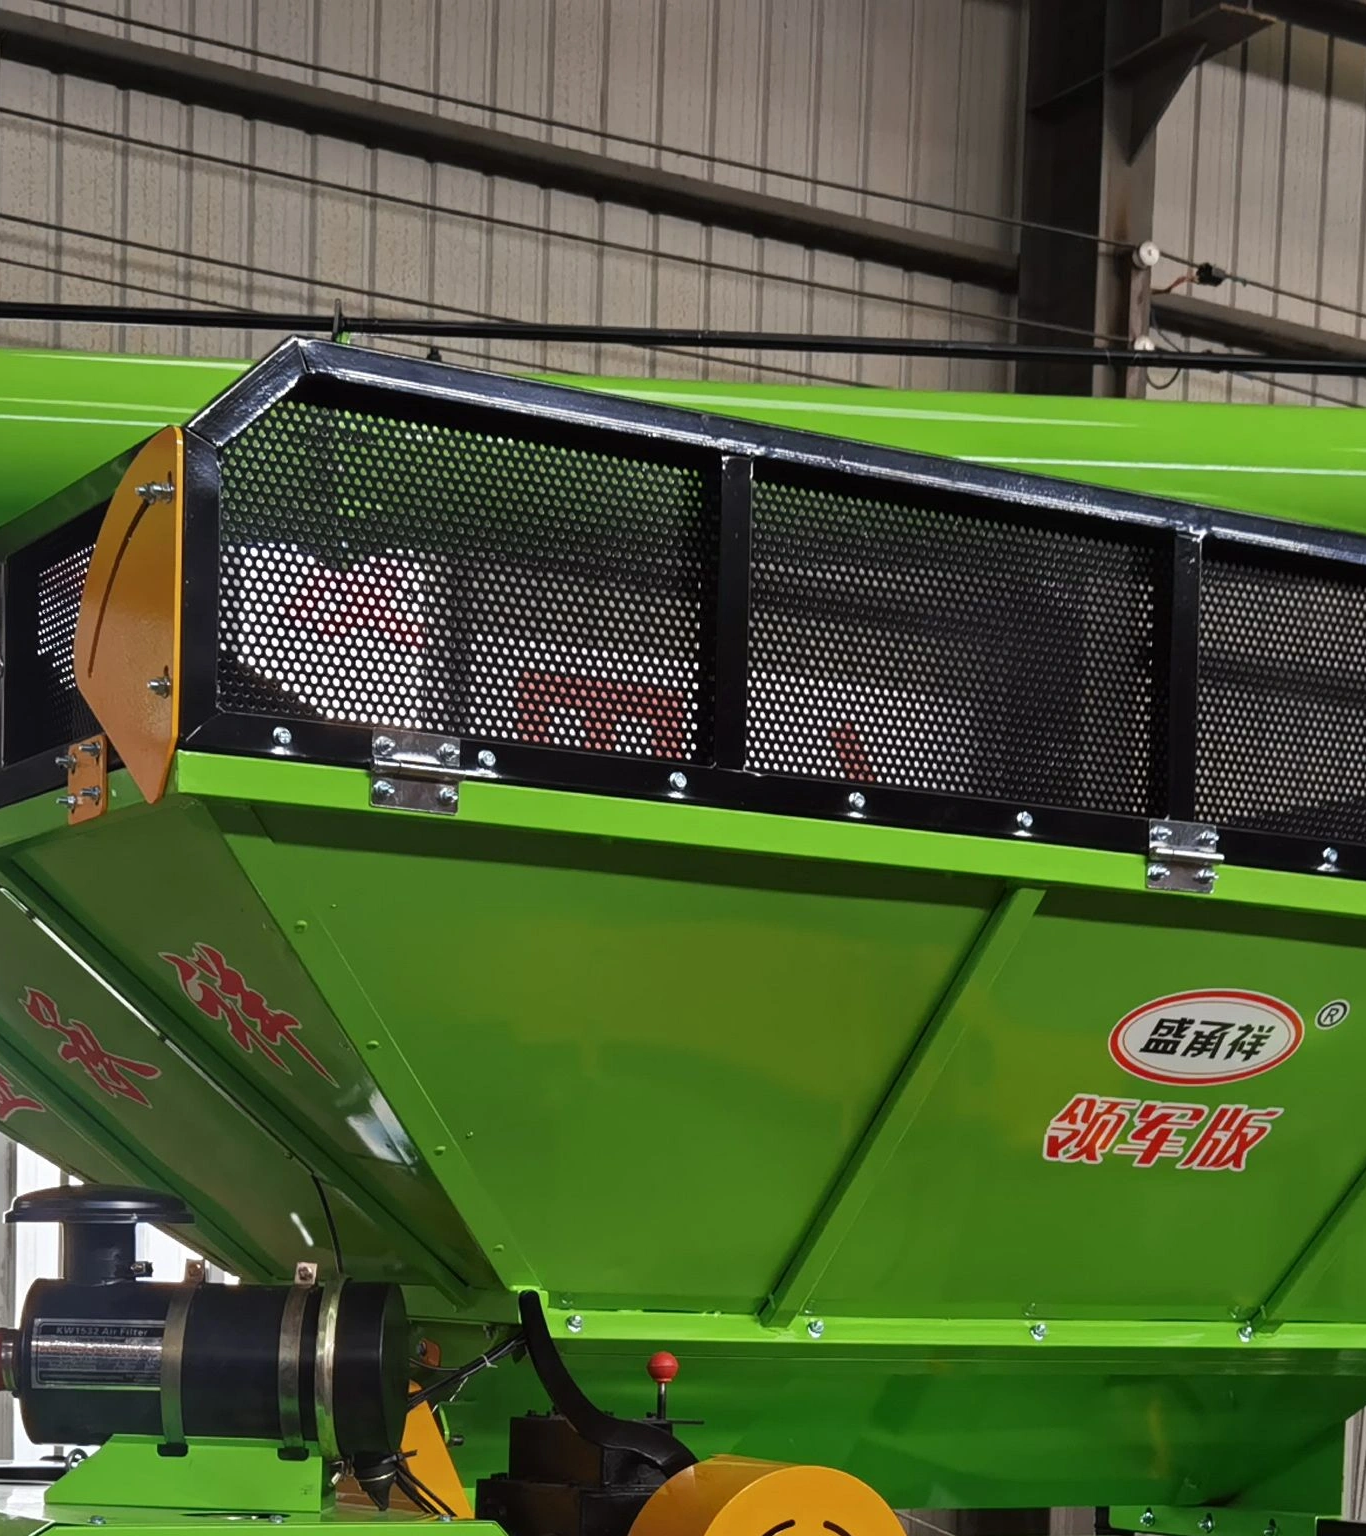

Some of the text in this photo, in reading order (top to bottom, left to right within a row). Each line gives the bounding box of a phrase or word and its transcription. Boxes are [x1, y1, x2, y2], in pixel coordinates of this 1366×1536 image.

[1043, 1094, 1284, 1171] 领军版
[101, 1327, 117, 1336] Air
[120, 1327, 148, 1337] Filter
